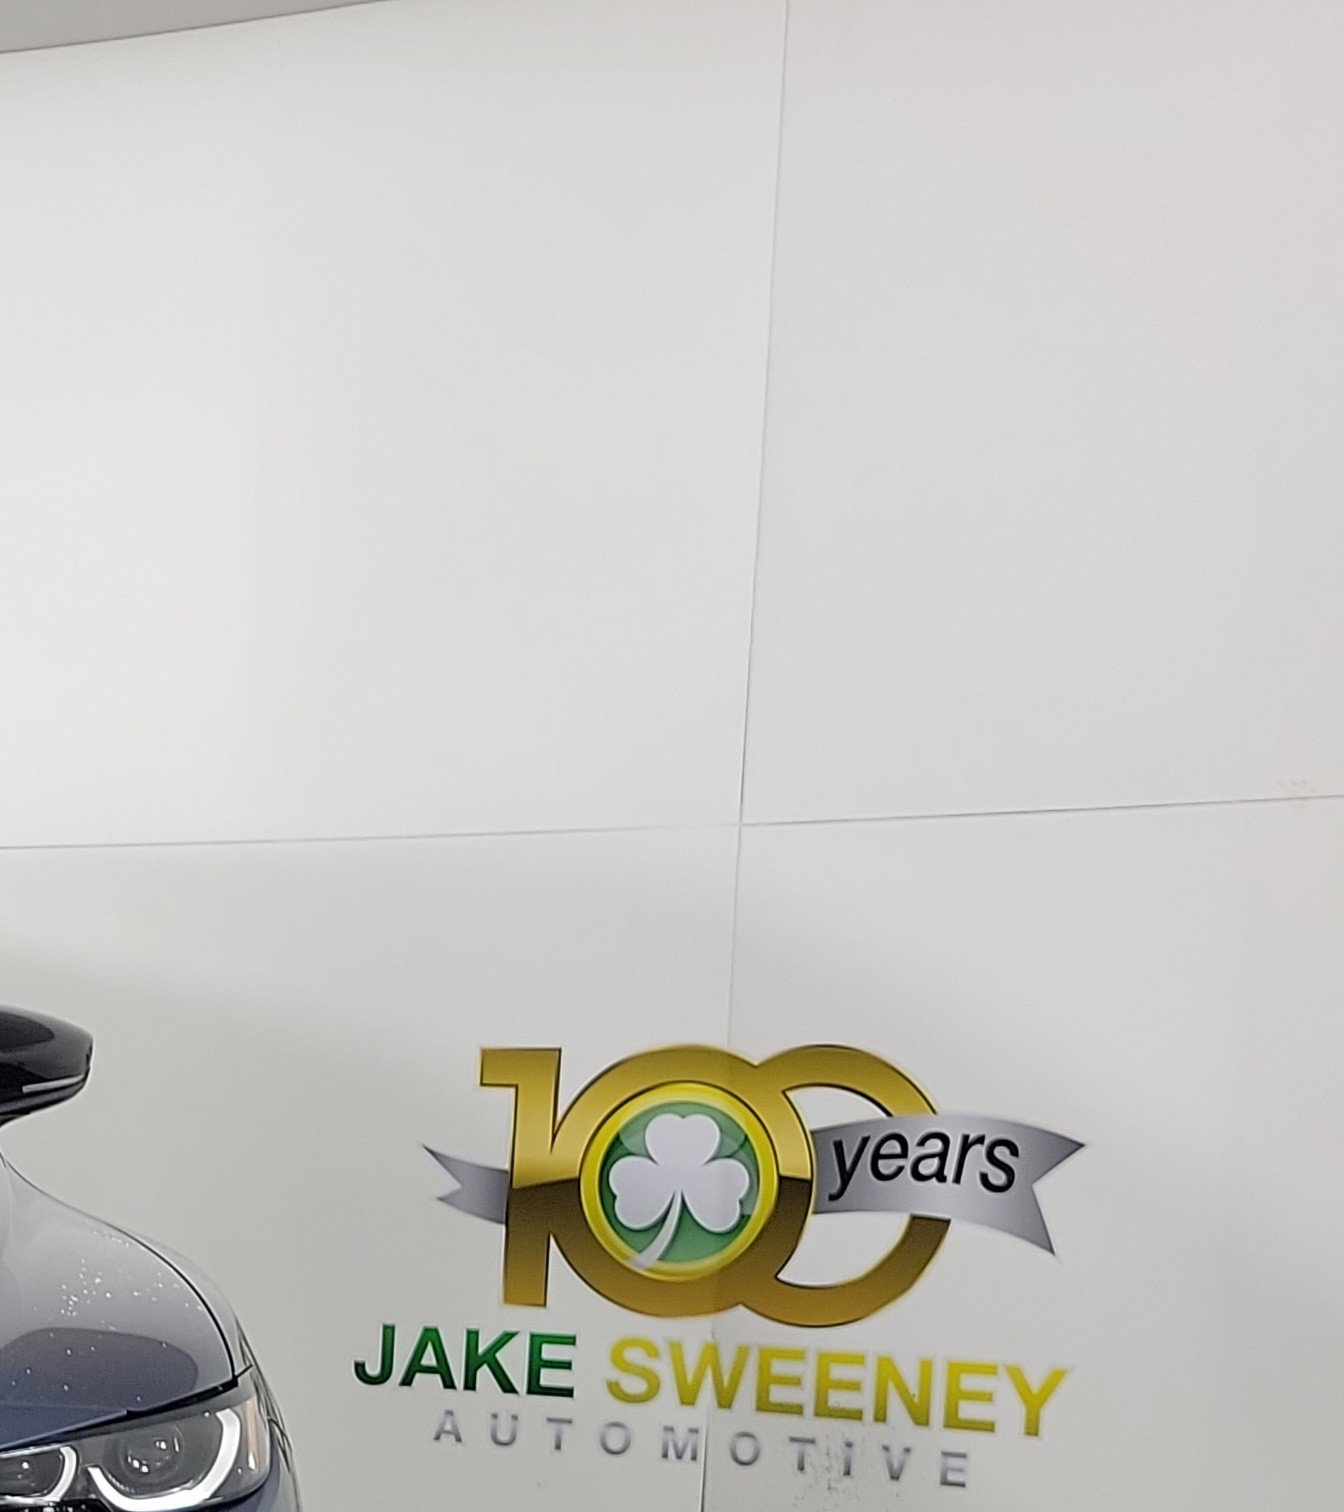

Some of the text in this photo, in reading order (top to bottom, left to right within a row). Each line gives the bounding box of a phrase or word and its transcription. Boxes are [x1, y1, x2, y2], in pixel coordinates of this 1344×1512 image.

[479, 1044, 1020, 1328] 100 years
[353, 1324, 1067, 1436] JAKE SWEENEY
[433, 1410, 968, 1488] AUTOMOTIVE
